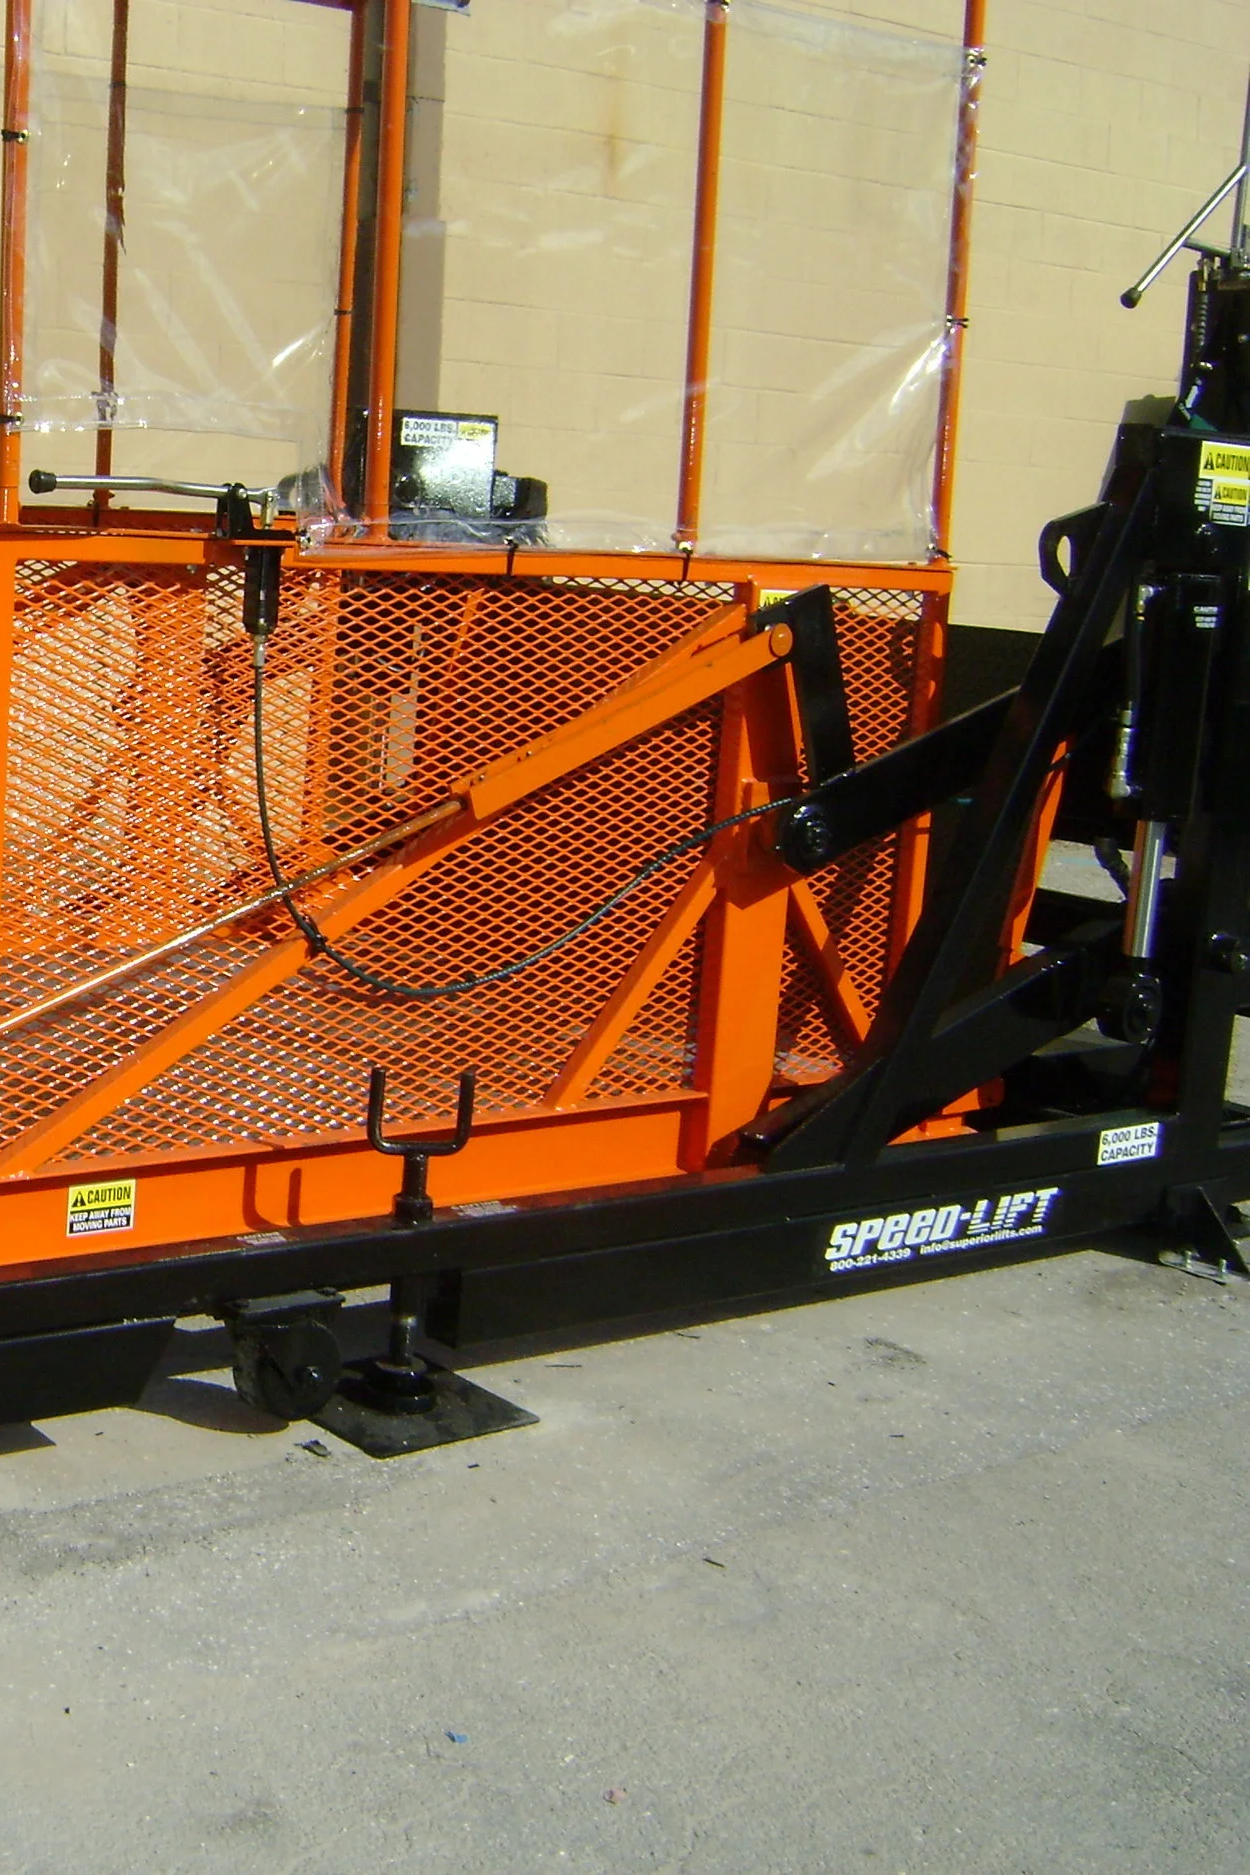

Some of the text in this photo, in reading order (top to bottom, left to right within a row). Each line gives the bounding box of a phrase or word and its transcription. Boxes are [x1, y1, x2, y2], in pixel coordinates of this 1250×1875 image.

[404, 420, 431, 432] 6,000
[1216, 452, 1250, 472] CAUTION
[1222, 486, 1247, 501] CAUTION
[1102, 1130, 1131, 1146] 6,000
[1100, 1141, 1154, 1161] CAPACITY
[87, 1186, 131, 1204] CAUTION
[70, 1207, 131, 1222] KEEP AWAY FROM
[72, 1217, 127, 1232] MOVING PARTS
[829, 1224, 1043, 1272] 800-221-4339 info@superiorlifts.com
